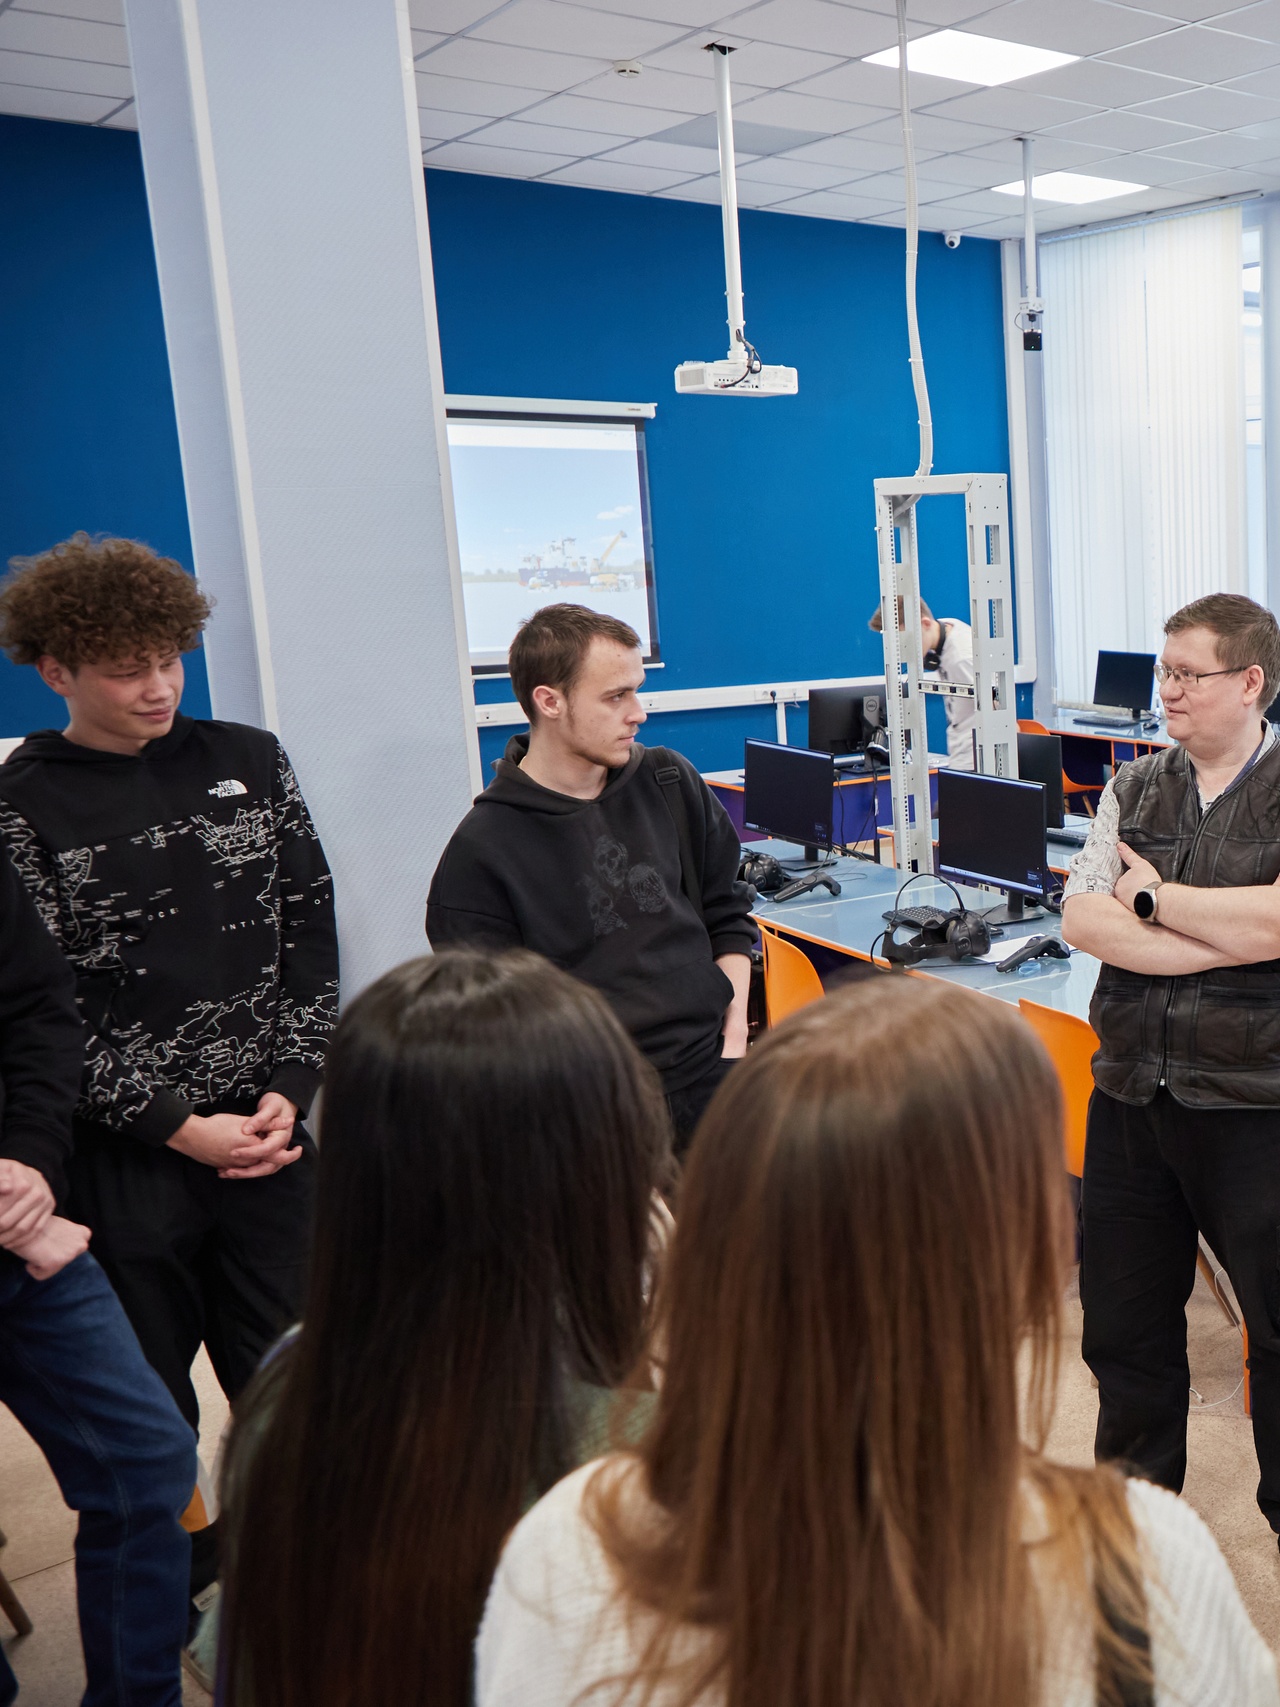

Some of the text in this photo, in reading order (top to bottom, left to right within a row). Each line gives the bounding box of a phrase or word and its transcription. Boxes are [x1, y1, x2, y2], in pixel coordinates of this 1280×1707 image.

[216, 779, 232, 787] THE
[208, 785, 233, 795] NORTH
[217, 790, 235, 798] FACE
